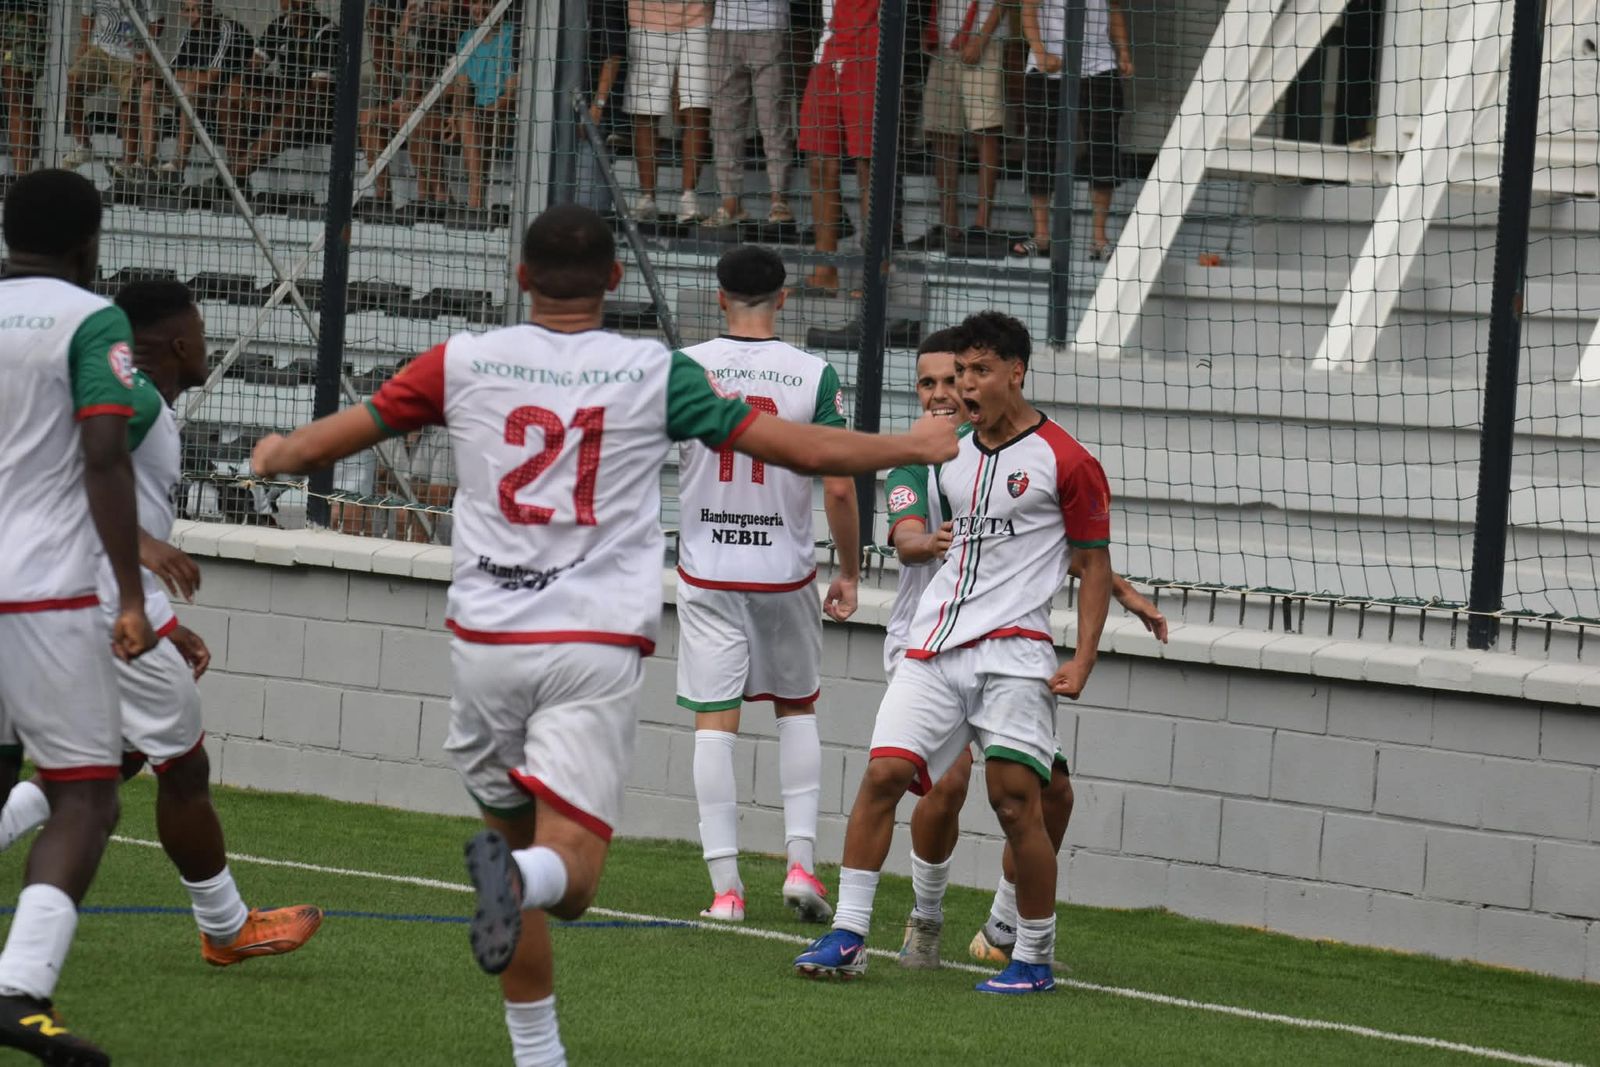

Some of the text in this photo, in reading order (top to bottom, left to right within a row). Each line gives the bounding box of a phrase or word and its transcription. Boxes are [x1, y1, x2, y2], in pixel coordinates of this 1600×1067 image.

[471, 360, 645, 387] SPORTING ATLCO
[712, 367, 803, 387] RTING ATLCO
[497, 405, 606, 526] 21
[700, 508, 784, 528] Hamburgueseria
[711, 528, 773, 547] NEBIL
